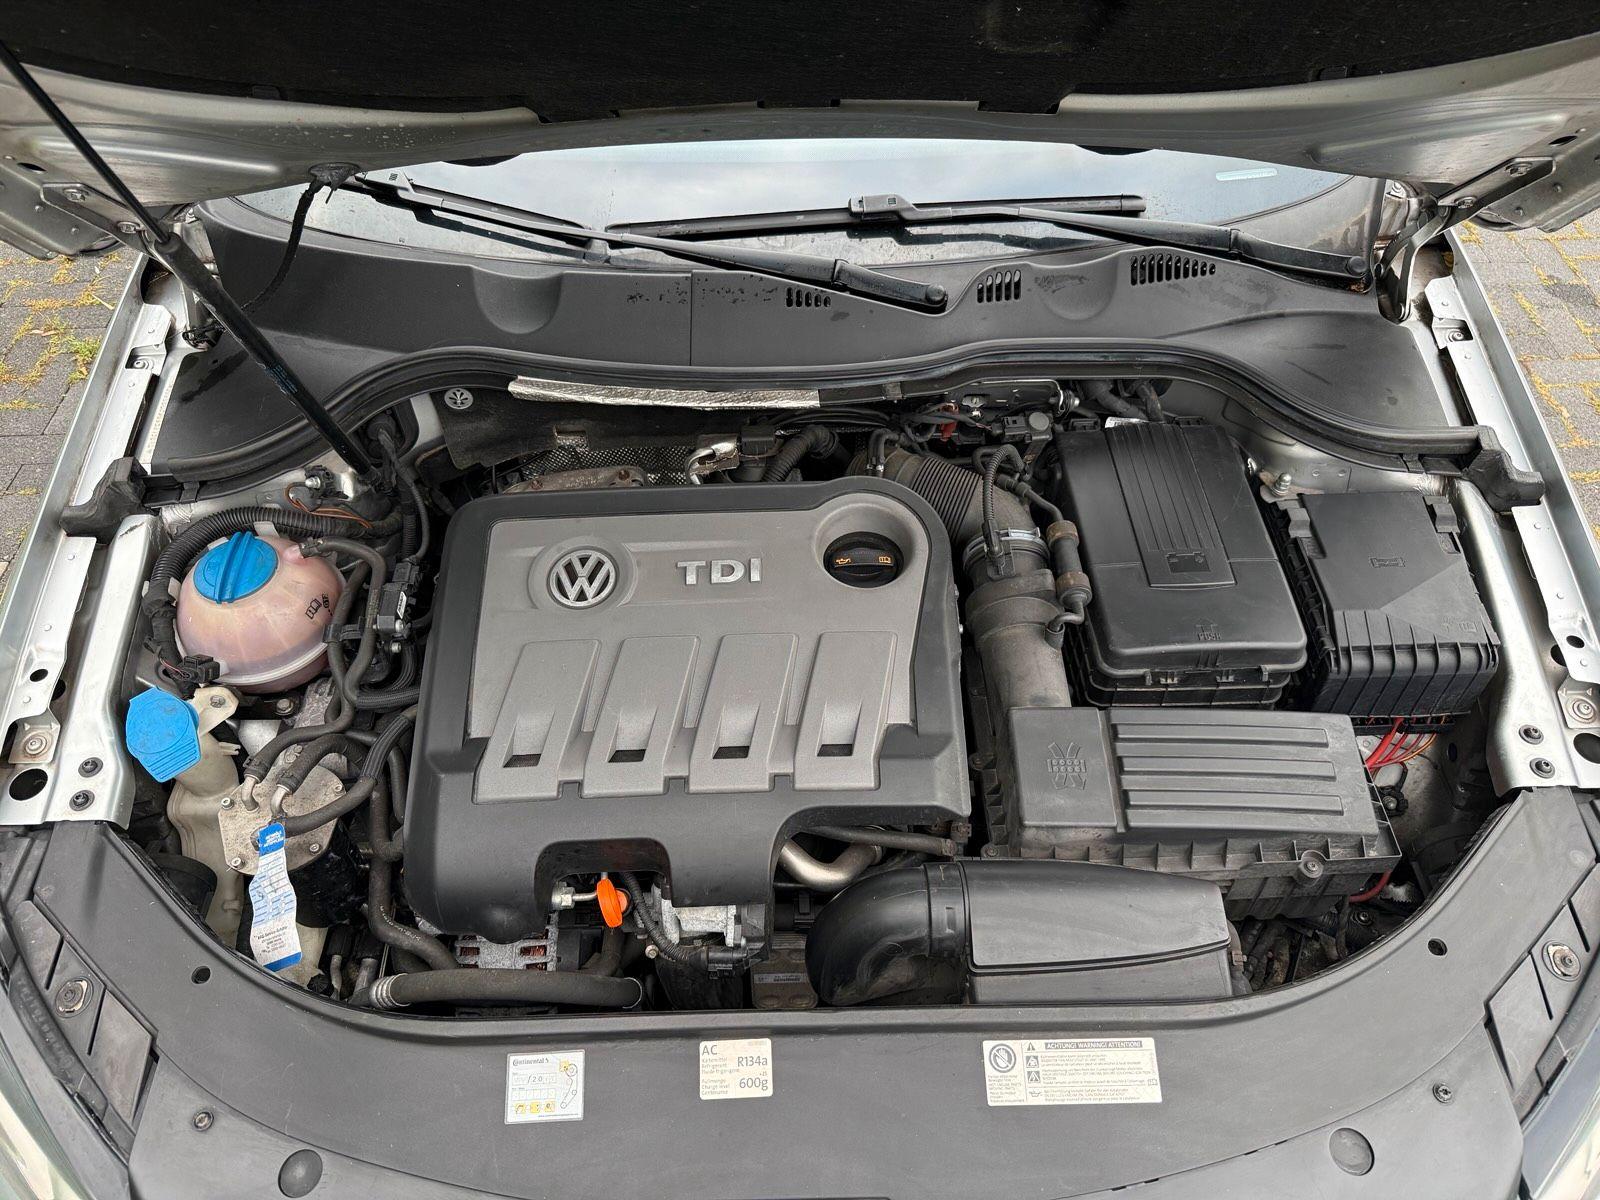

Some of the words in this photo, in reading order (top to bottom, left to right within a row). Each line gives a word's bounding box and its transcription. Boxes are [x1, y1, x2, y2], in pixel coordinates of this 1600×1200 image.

[677, 557, 762, 586] TDI
[702, 1044, 718, 1056] AC
[1047, 1042, 1077, 1050] ACHTUNG!
[737, 1055, 769, 1067] R134a
[739, 1077, 769, 1091] 600g
